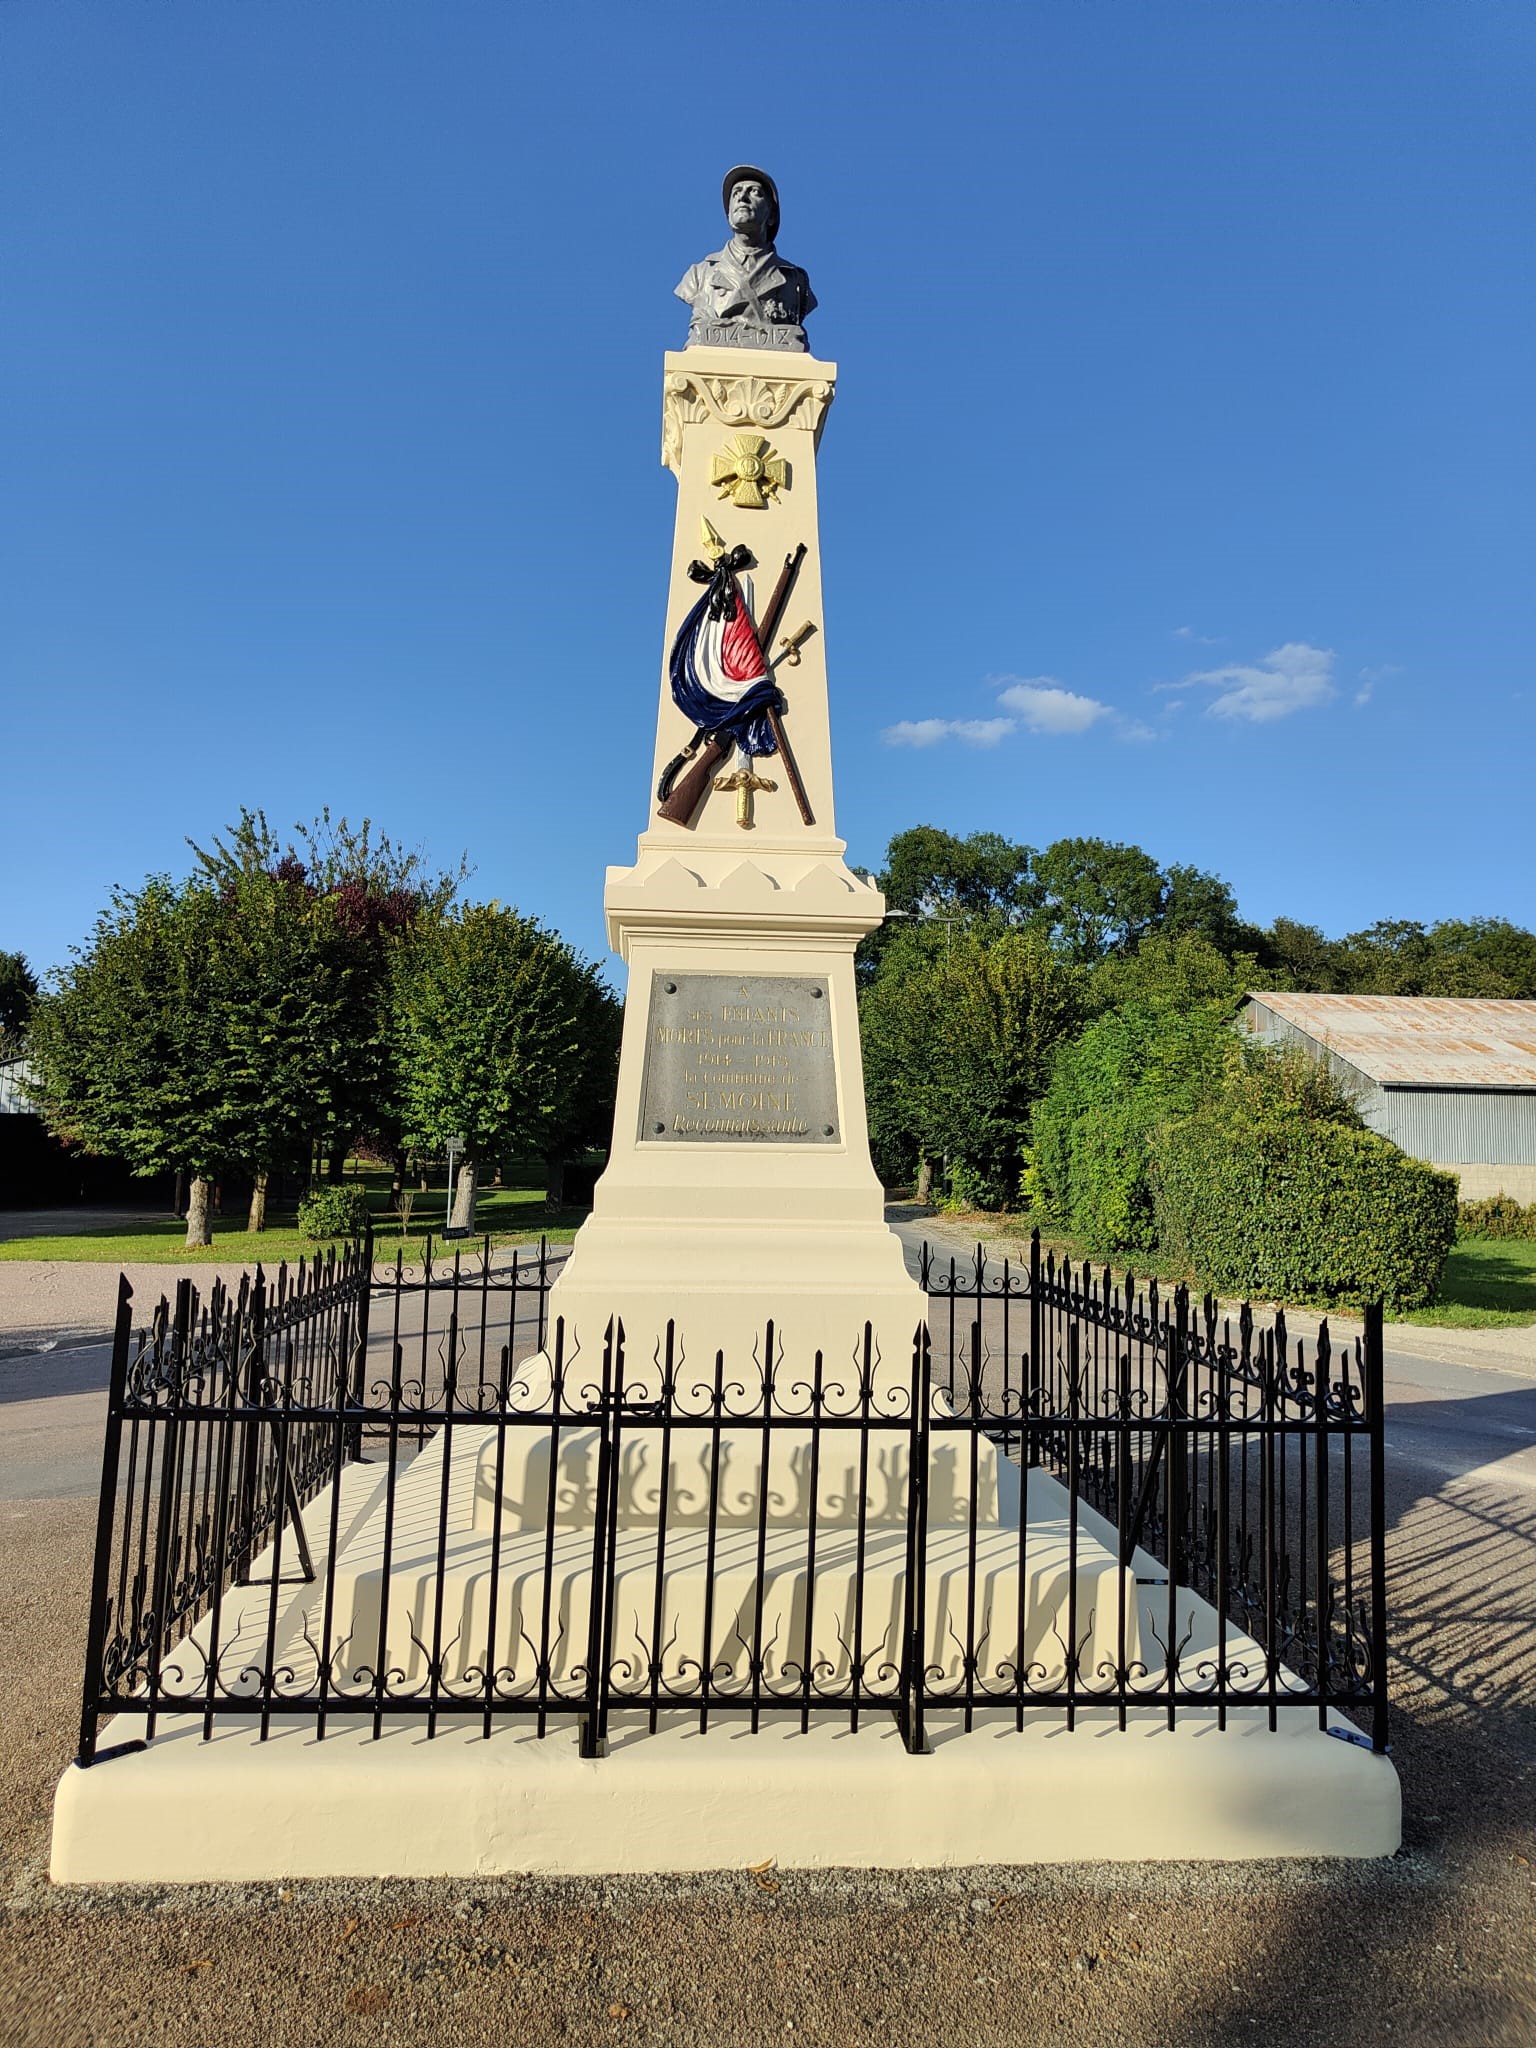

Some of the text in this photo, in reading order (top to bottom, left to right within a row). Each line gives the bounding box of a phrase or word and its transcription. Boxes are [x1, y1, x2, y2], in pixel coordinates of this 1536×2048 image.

[739, 984, 750, 1000] A
[721, 1006, 800, 1023] ENFANTS
[657, 1027, 830, 1049] MORTS pour la FRANCE
